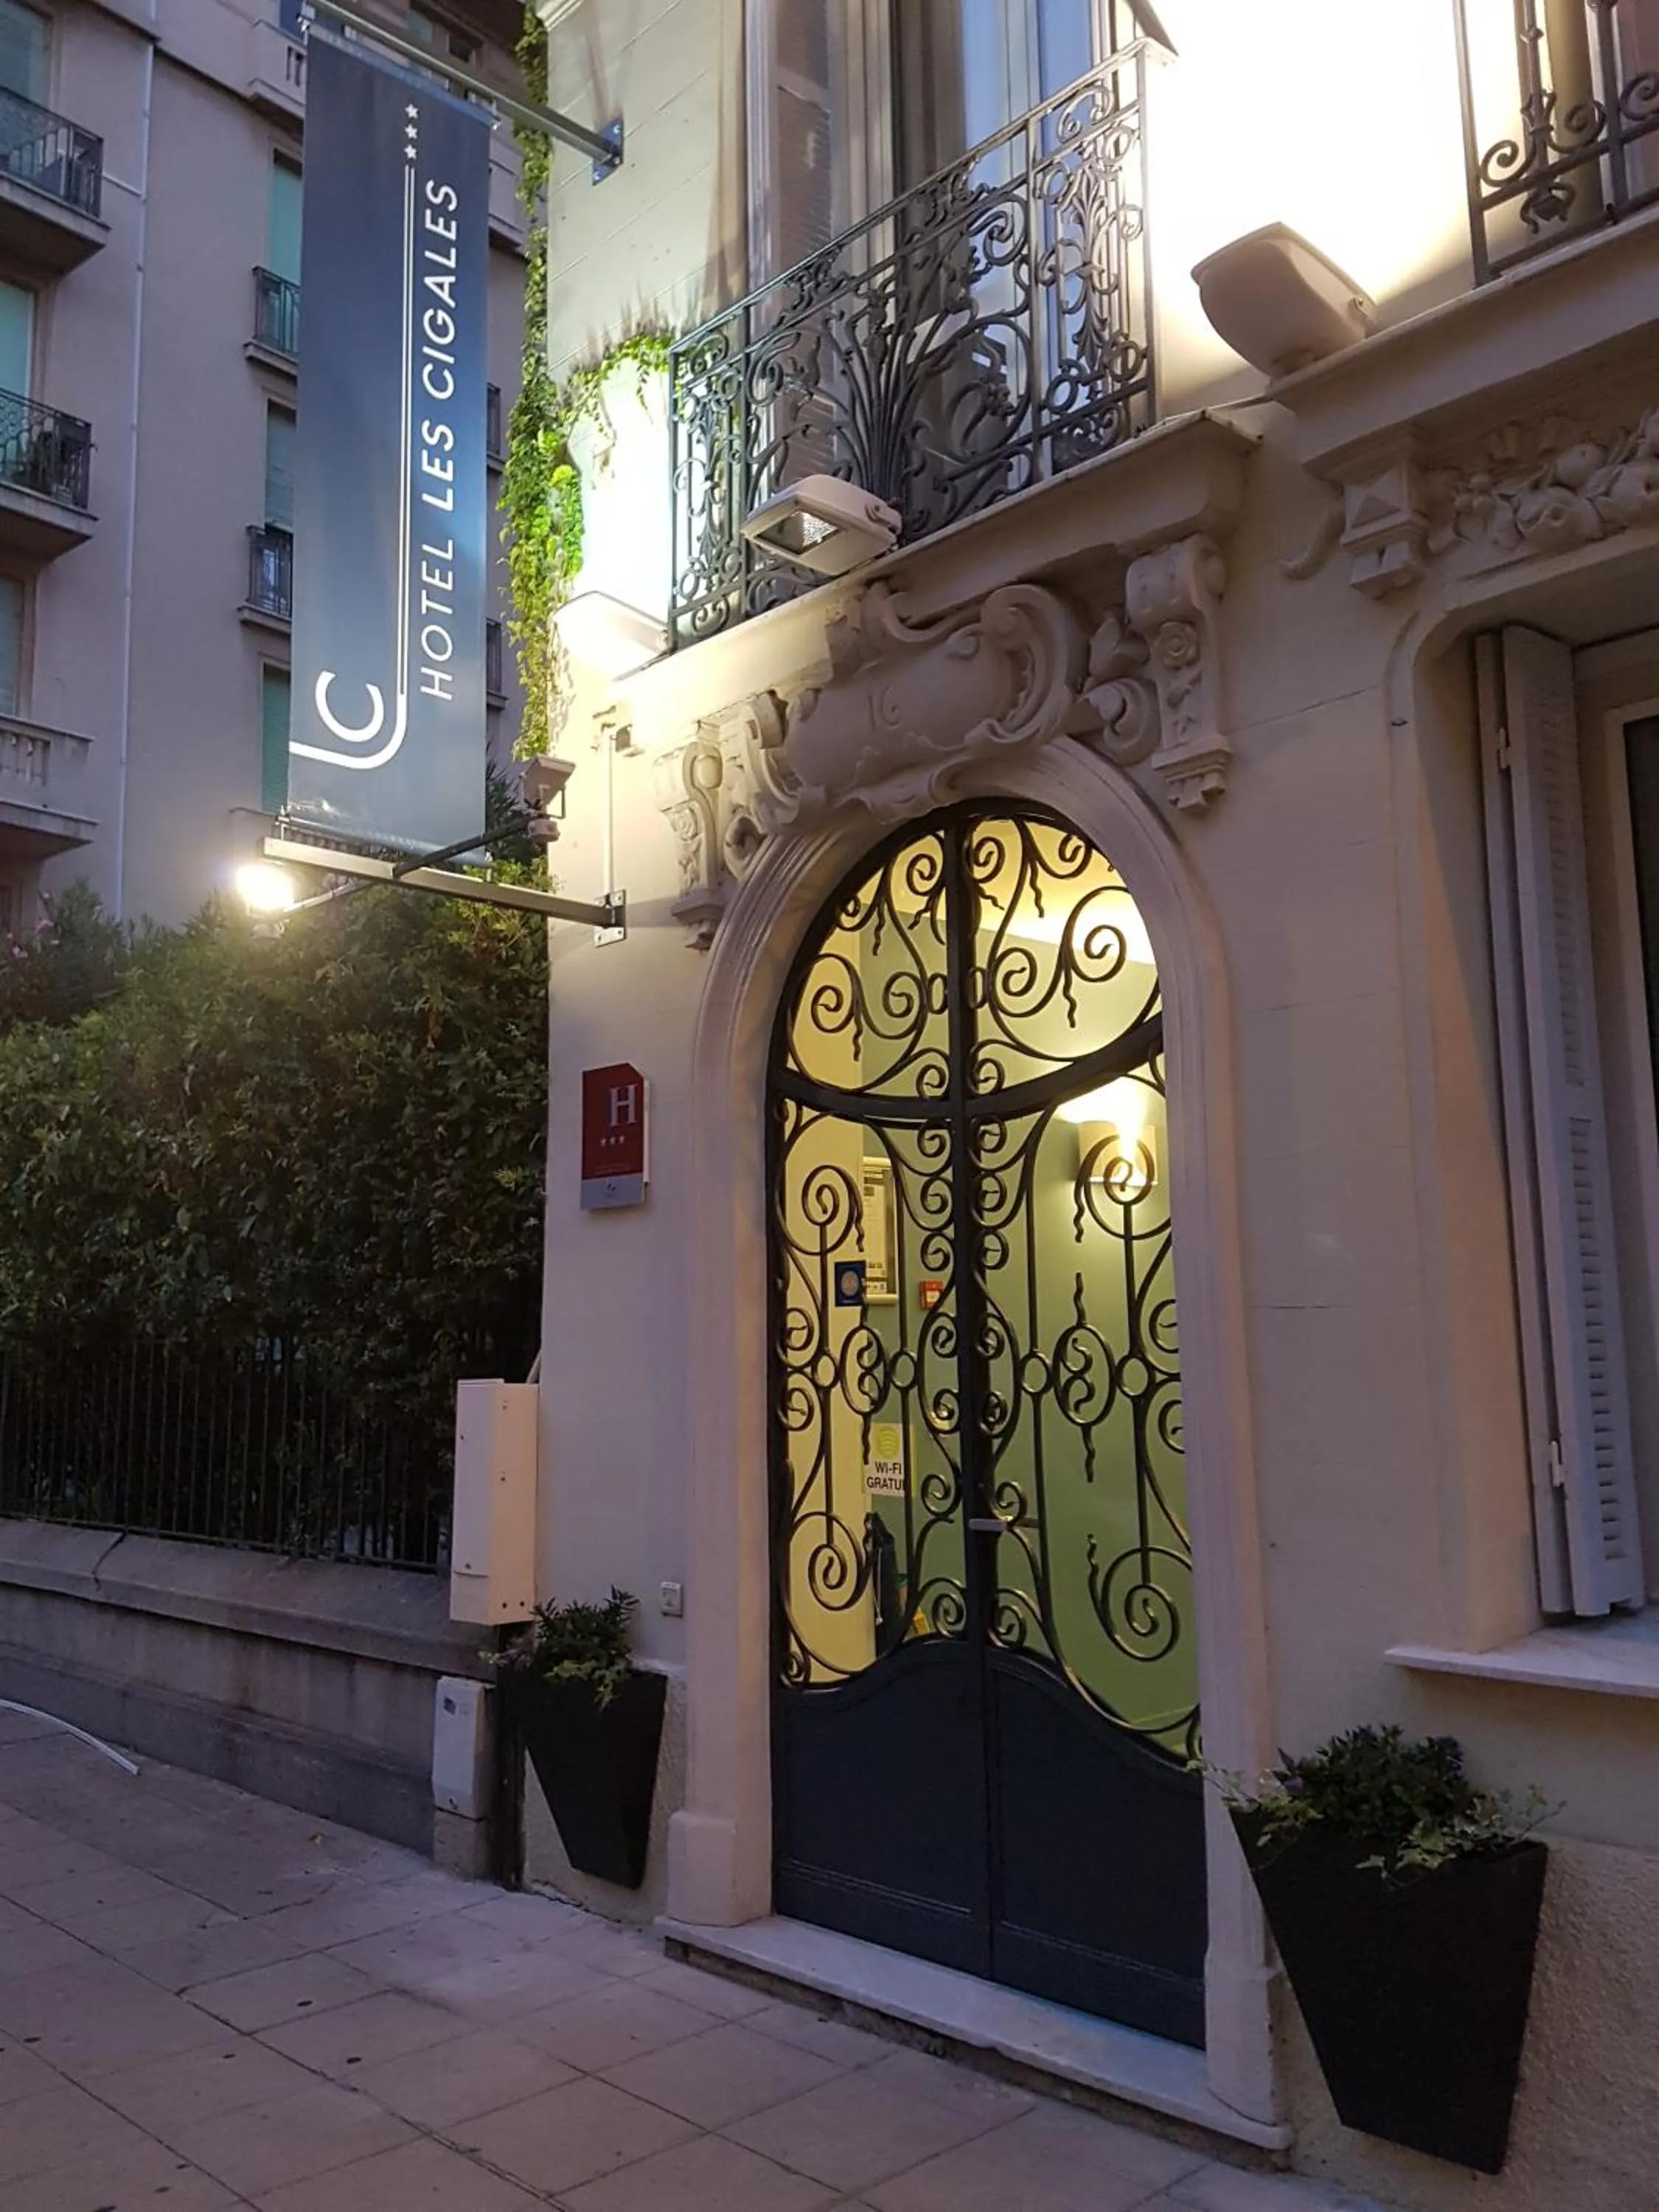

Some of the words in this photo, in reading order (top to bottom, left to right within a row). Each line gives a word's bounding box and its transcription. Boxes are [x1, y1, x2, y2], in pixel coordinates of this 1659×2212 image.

[422, 179, 459, 400] CIGALES
[421, 420, 455, 512] LES
[420, 539, 454, 701] HOTEL
[610, 1084, 638, 1126] H
[875, 1461, 902, 1475] WI-FI
